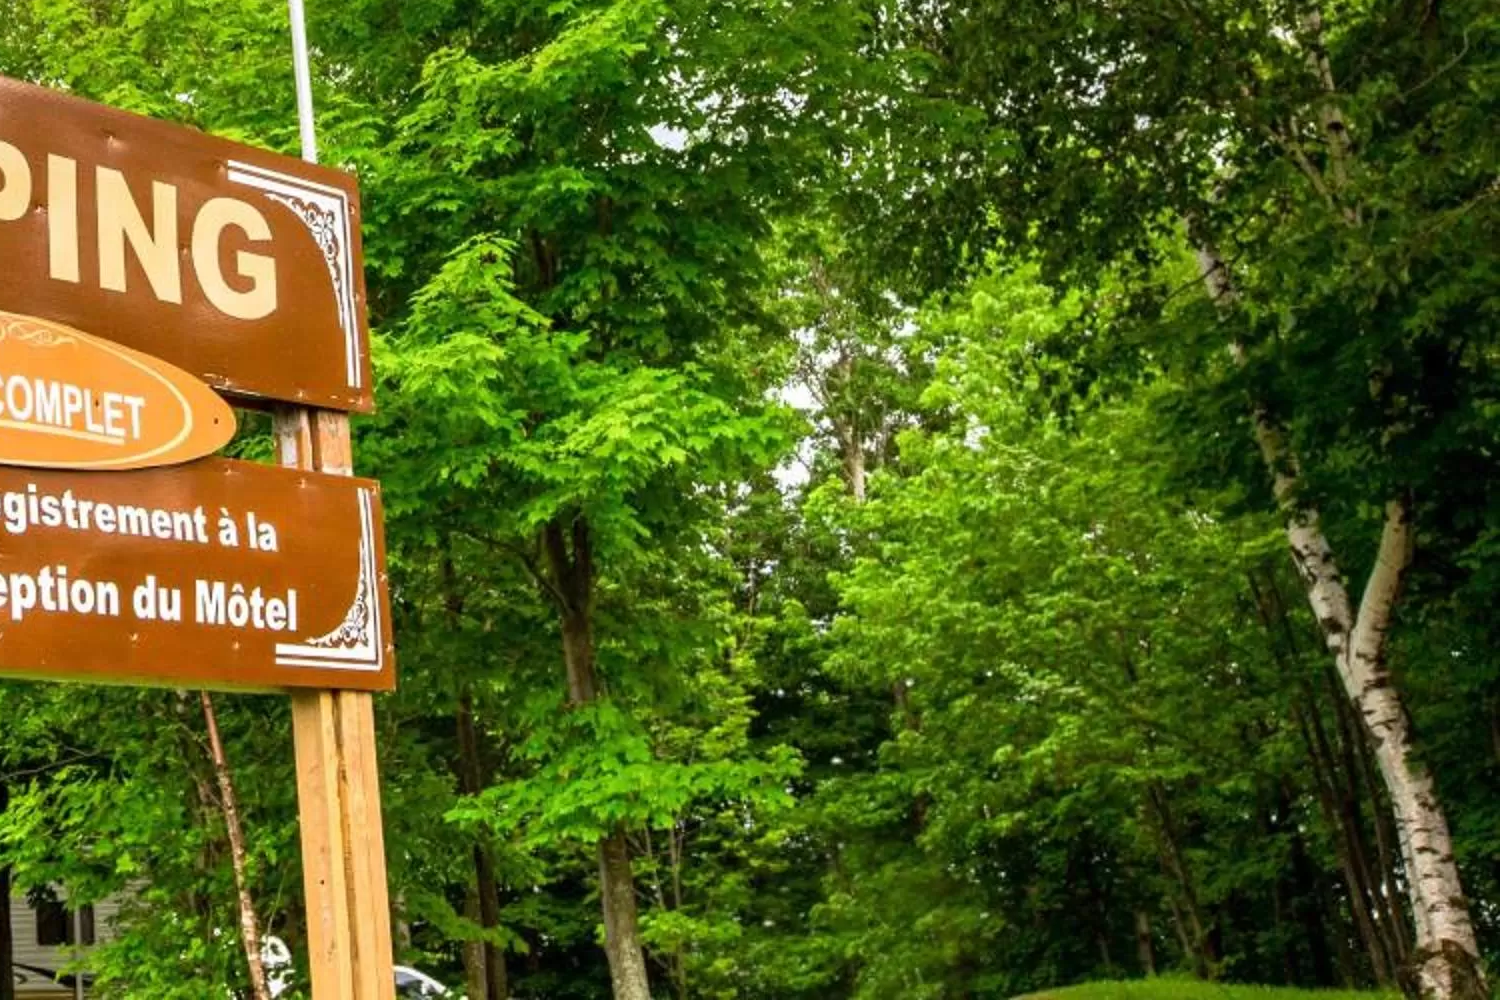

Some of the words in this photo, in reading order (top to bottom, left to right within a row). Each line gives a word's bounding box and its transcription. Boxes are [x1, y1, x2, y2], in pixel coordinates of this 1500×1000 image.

[218, 505, 240, 547] à
[247, 512, 278, 552] la
[133, 575, 181, 622] du
[195, 578, 297, 631] Môtel
